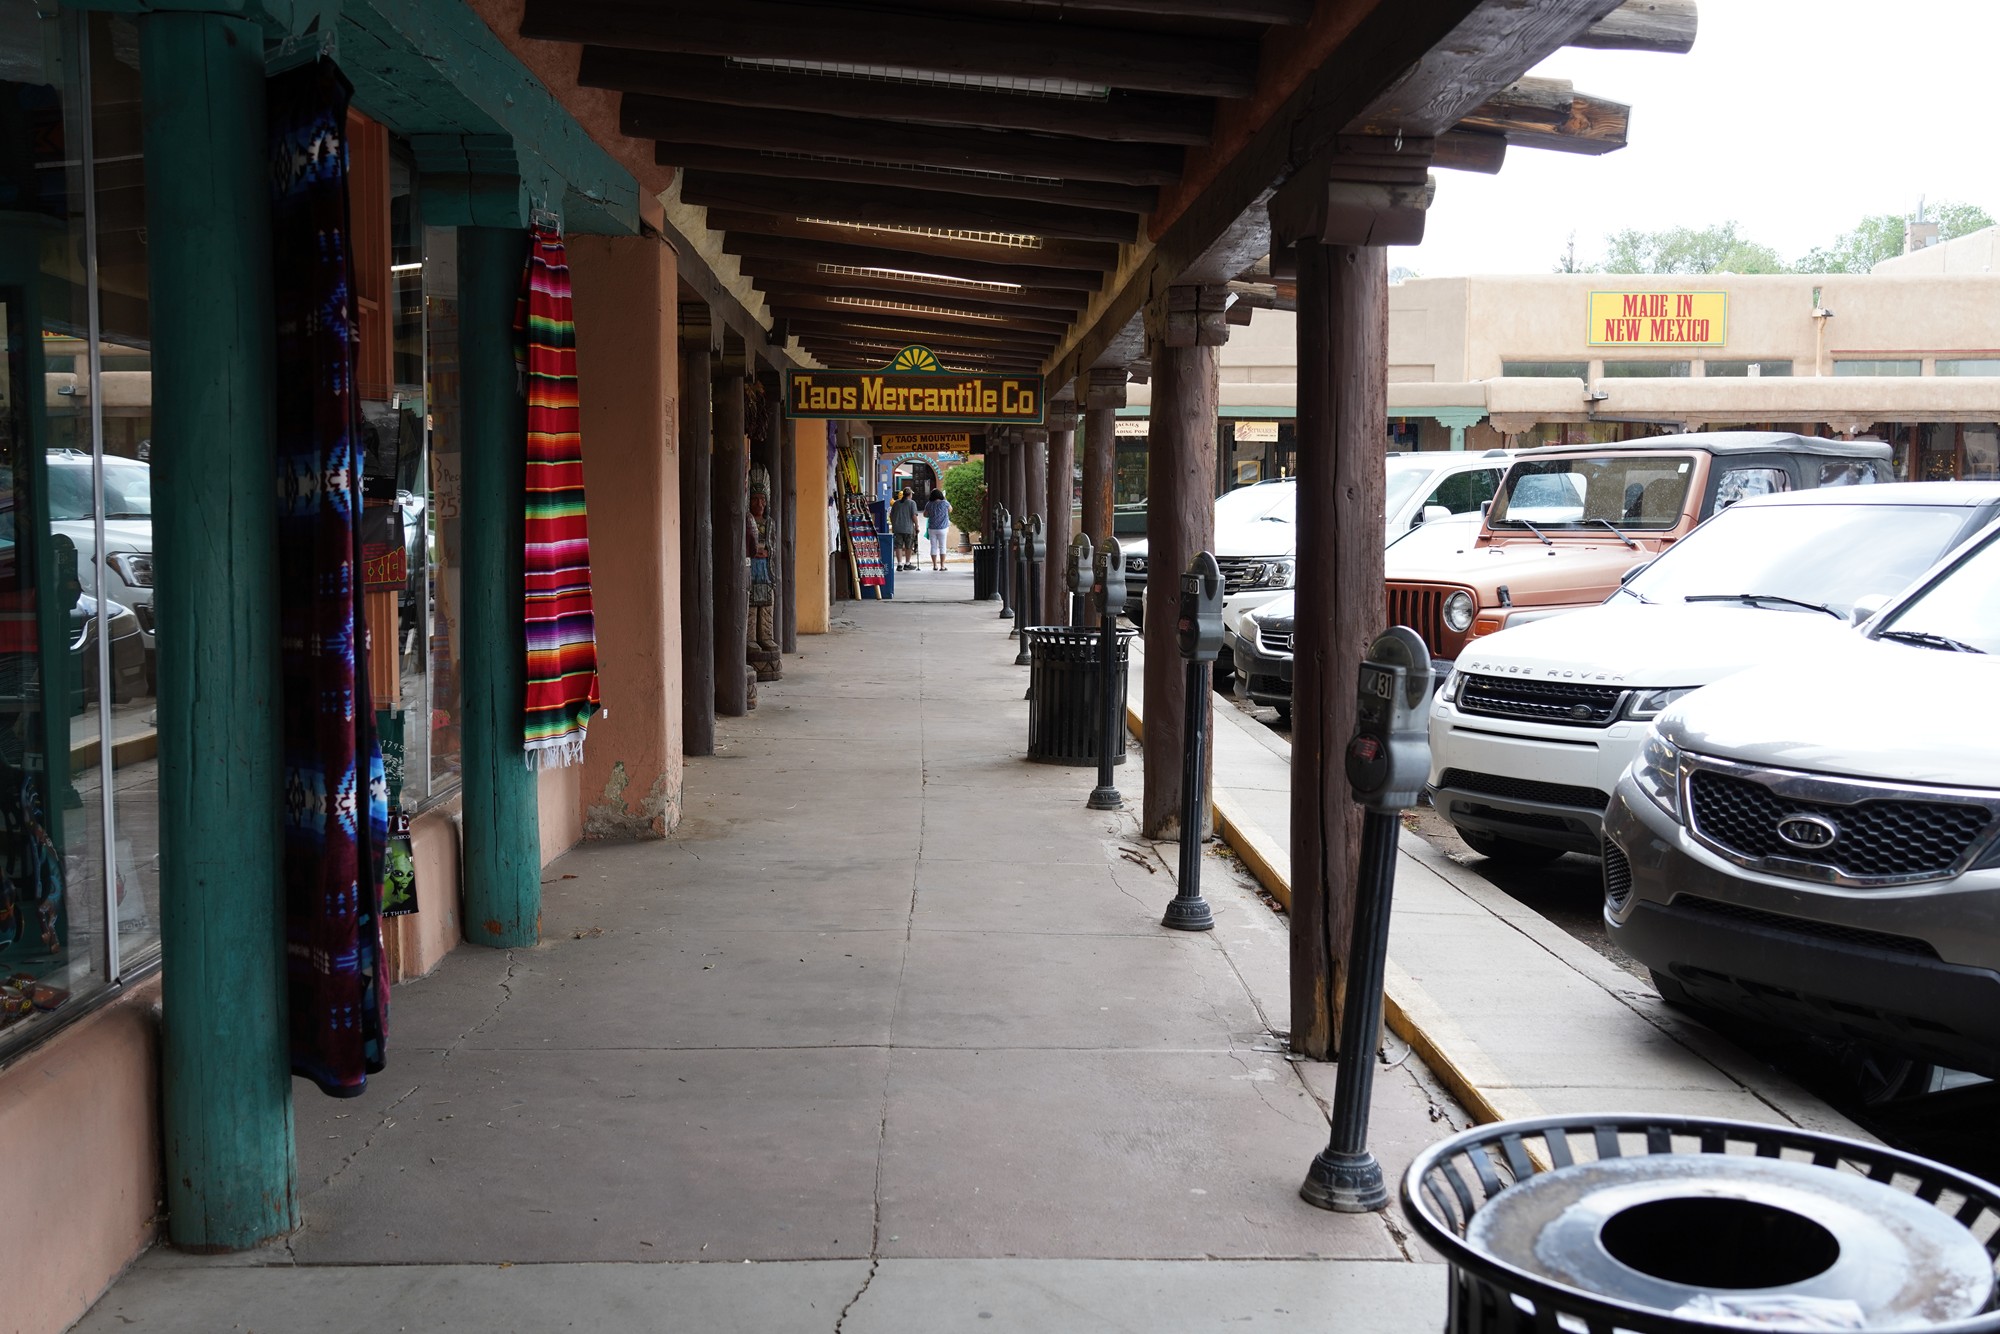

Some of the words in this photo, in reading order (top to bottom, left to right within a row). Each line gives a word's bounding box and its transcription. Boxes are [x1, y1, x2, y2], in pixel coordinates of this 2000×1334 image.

[1622, 294, 1668, 318] MADE
[1675, 294, 1694, 318] IN
[1604, 318, 1642, 342] NEW
[1649, 318, 1710, 343] MEXICO
[794, 375, 857, 410] Taos
[861, 376, 998, 414] Mercantile
[895, 435, 918, 443] TAOS
[920, 433, 966, 443] MOUNTAIN
[911, 442, 951, 451] CANDLES
[892, 451, 916, 466] ALLEY
[917, 452, 944, 481] CANTINA
[1190, 579, 1198, 594] 30
[1470, 661, 1534, 675] RANGE
[1547, 669, 1625, 682] ROVER
[1379, 674, 1392, 698] 31
[1789, 822, 1824, 842] KIA
